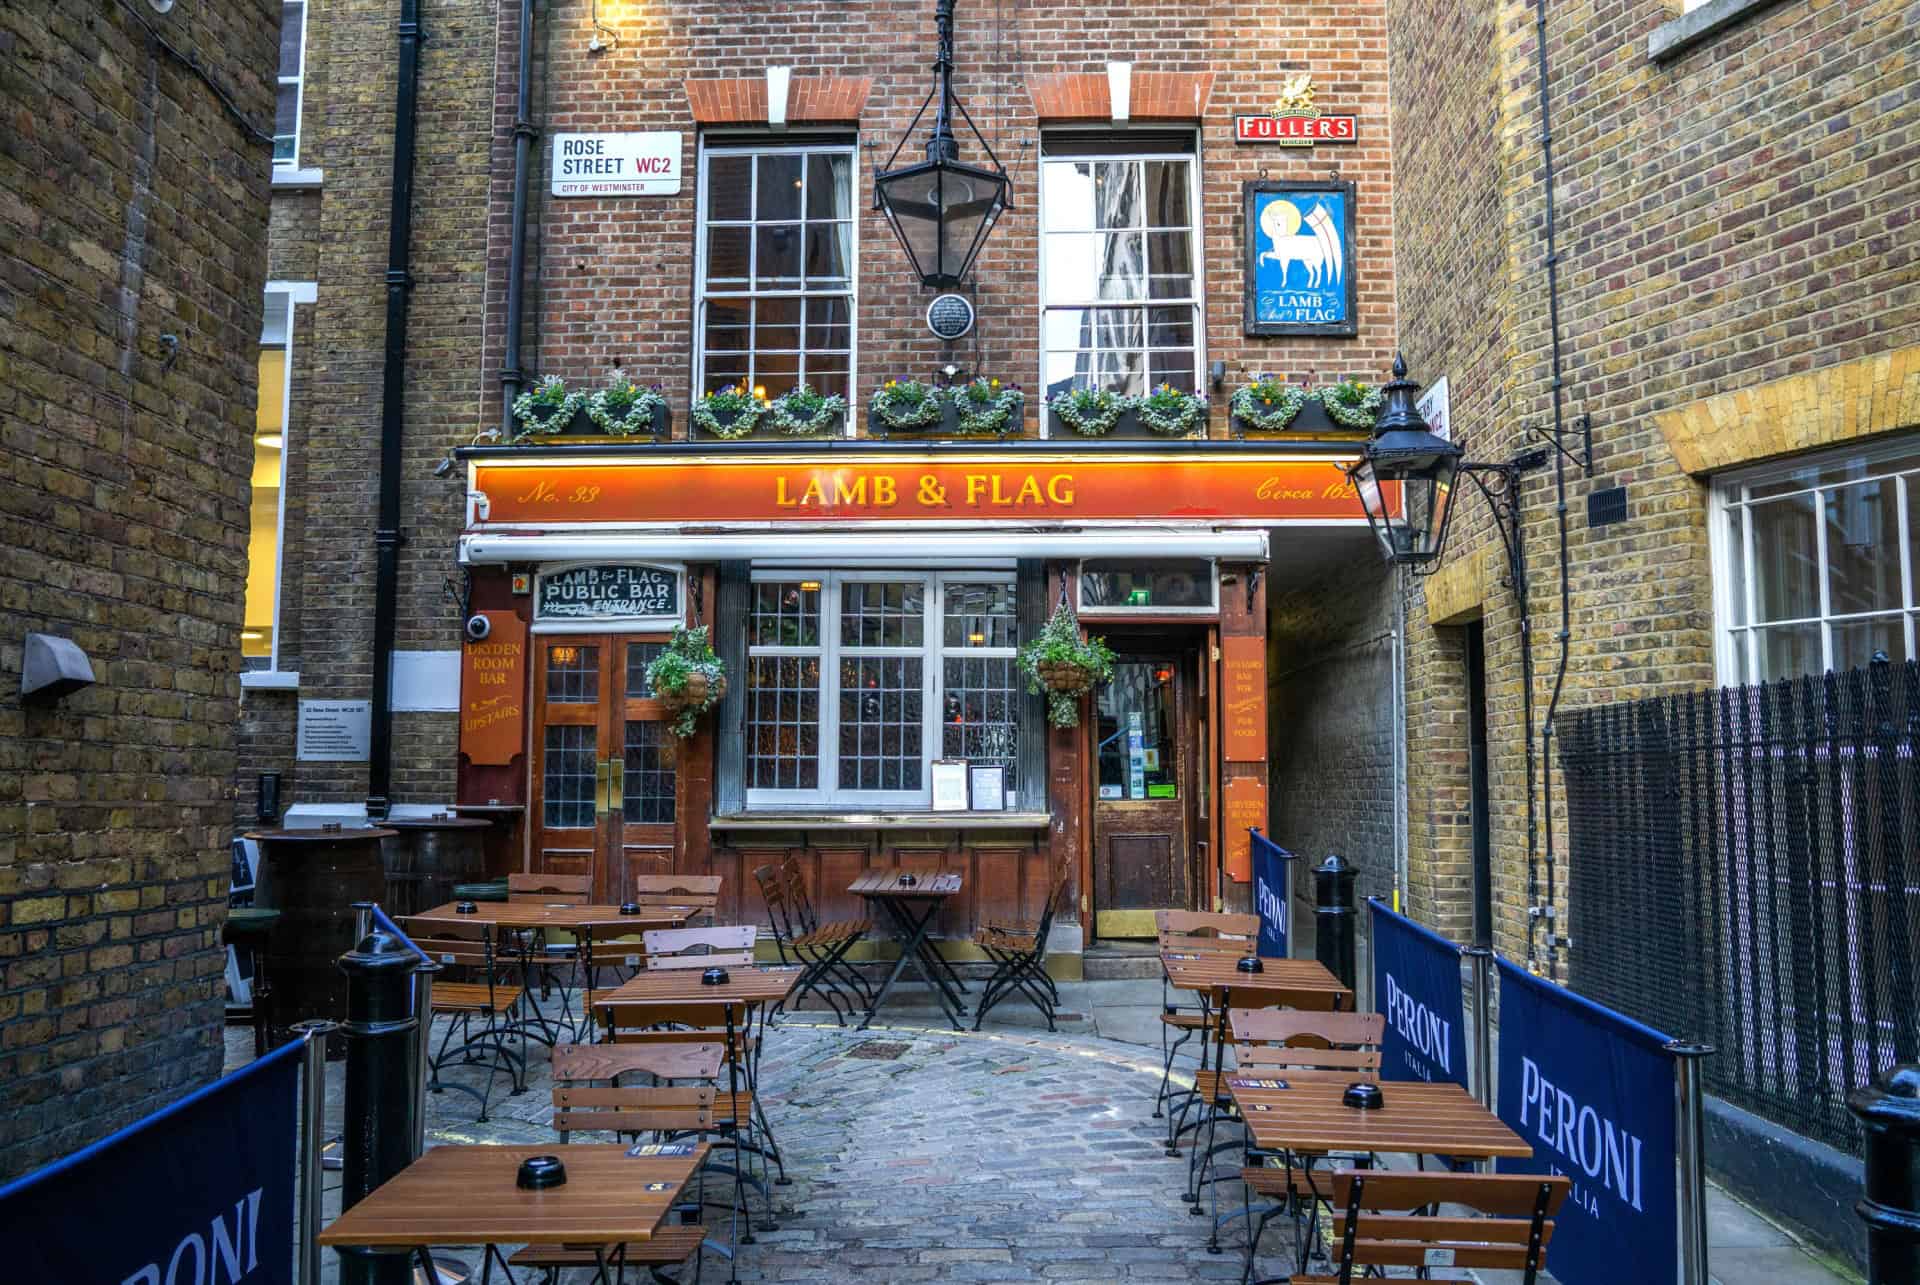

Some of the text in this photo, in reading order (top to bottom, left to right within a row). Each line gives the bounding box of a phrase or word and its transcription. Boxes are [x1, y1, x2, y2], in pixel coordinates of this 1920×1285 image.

[1243, 118, 1348, 138] FULLER'S
[563, 140, 605, 156] ROSE
[563, 157, 671, 174] STREET WC2
[562, 183, 645, 193] CITY OF WESTMINSTER
[1279, 295, 1322, 308] LAMB
[1295, 308, 1336, 321] FLAG
[517, 480, 560, 503] No.
[568, 486, 601, 503] 33
[776, 475, 898, 505] LAMB
[917, 474, 946, 506] &
[965, 474, 1075, 505] FLAG
[1256, 477, 1313, 500] Circa
[554, 568, 599, 585] LAMB
[617, 569, 662, 584] FLAG
[546, 584, 669, 600] PUBLIC BAR
[468, 643, 521, 655] DRYDEN
[473, 658, 515, 671] ROOM
[479, 672, 505, 685] BAR
[465, 704, 520, 731] UPSTAIRS
[1386, 972, 1451, 1074] PERONI
[1520, 1055, 1642, 1213] PERONI
[1550, 1163, 1600, 1220] ITLIA
[121, 1186, 263, 1285] ONI
